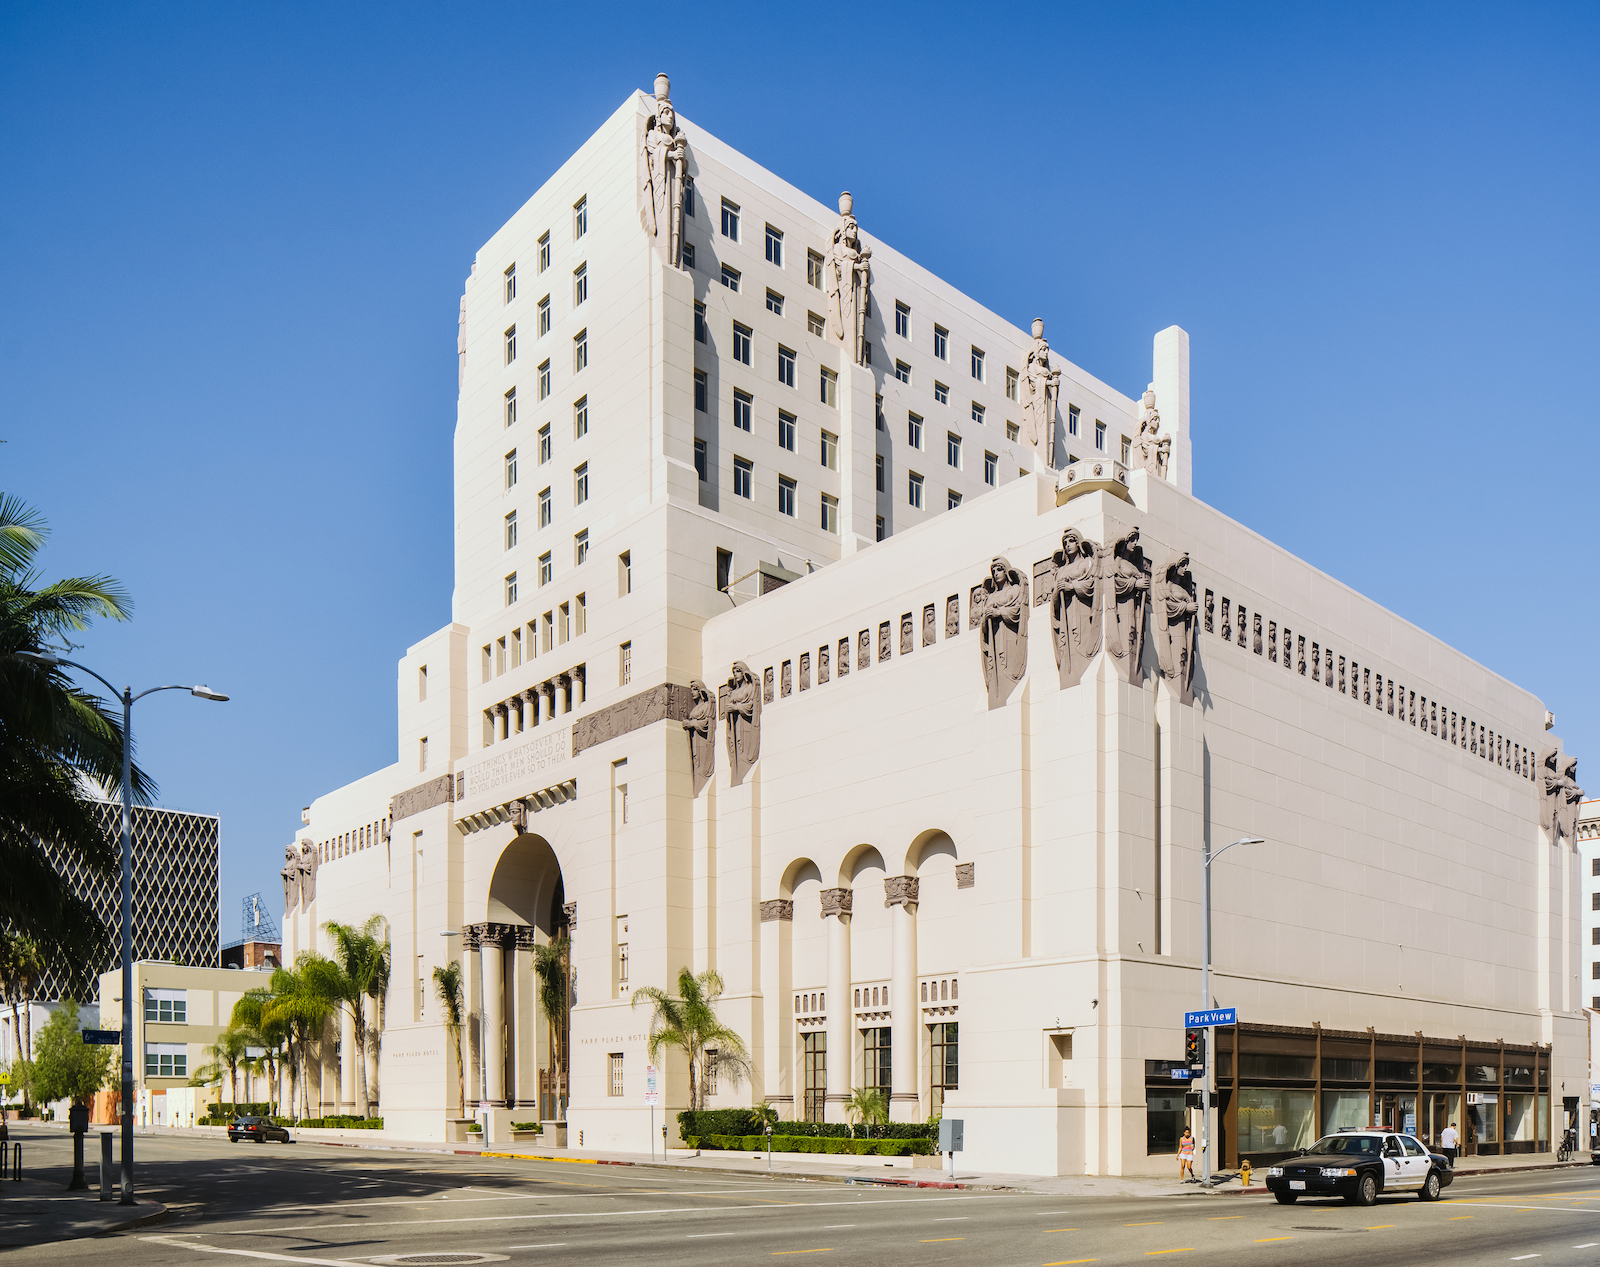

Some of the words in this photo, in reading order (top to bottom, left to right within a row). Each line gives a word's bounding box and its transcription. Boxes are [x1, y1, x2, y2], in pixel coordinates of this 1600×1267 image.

[469, 763, 481, 776] ALL
[482, 755, 506, 771] THINGS
[508, 735, 553, 760] WHATSOEVER
[556, 730, 566, 741] YE
[469, 770, 490, 785] WOULD
[492, 763, 508, 777] THAT
[510, 757, 525, 770] MEN
[527, 745, 553, 764] SHOULD
[556, 741, 566, 752] DO
[469, 786, 477, 796] TO
[478, 781, 489, 794] YOU
[491, 777, 500, 788] DO
[501, 773, 508, 784] YE
[510, 768, 526, 781] EVEN
[528, 763, 536, 774] SO
[536, 759, 546, 770] TO
[548, 752, 566, 766] THEM
[1189, 1014, 1209, 1024] Park
[1211, 1012, 1232, 1022] View
